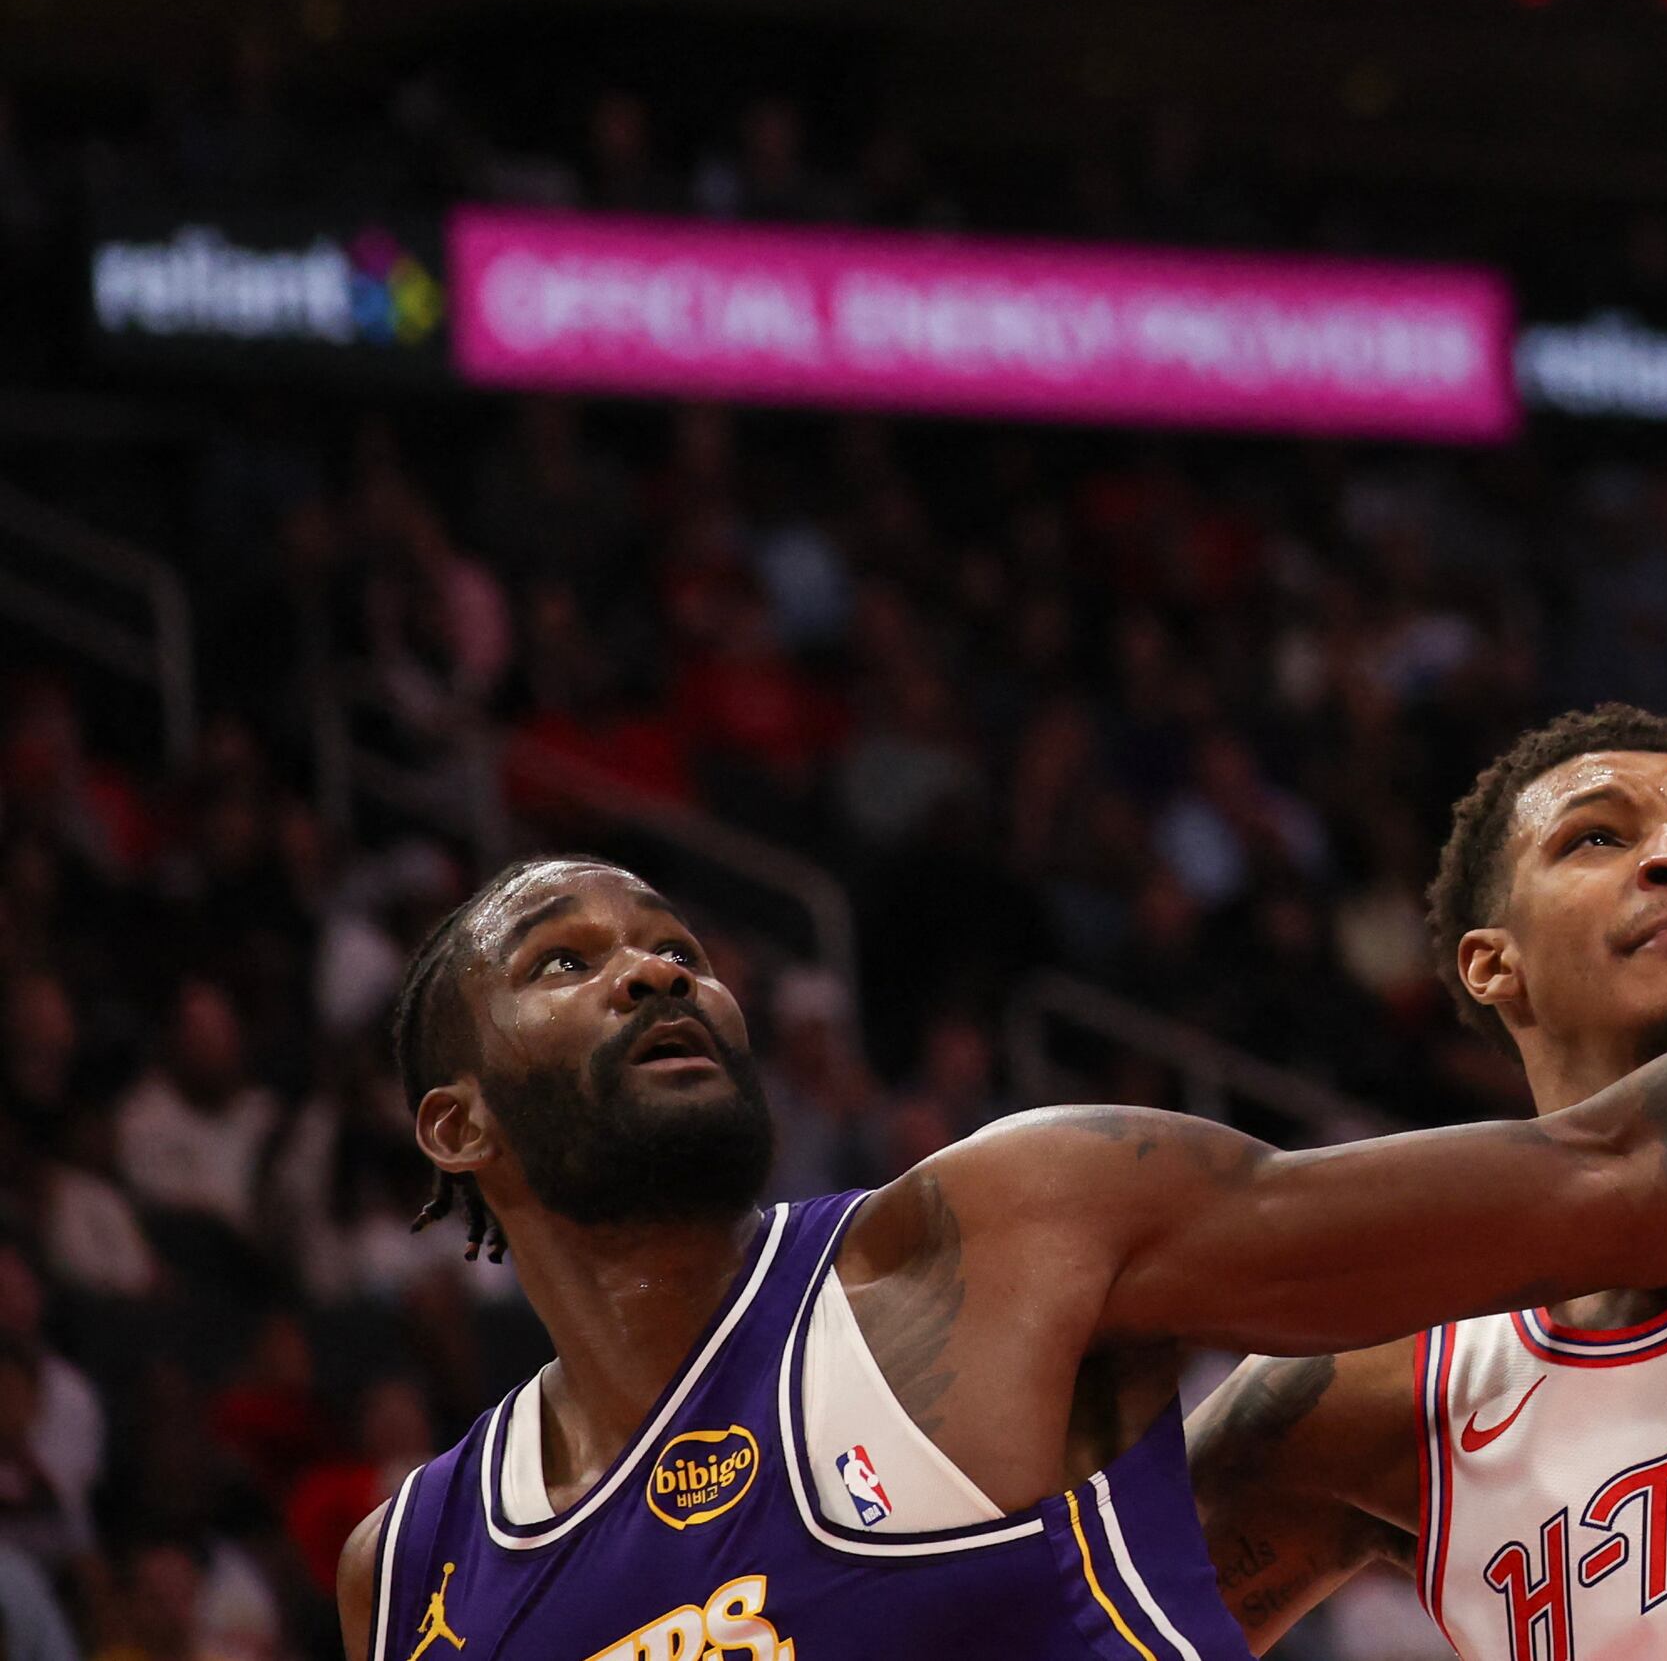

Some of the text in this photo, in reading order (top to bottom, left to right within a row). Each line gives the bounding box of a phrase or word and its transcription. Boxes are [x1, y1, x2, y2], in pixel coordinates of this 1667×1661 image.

[656, 1447, 752, 1495] bibigo
[676, 1485, 719, 1508] 비비고
[862, 1503, 882, 1525] NBA
